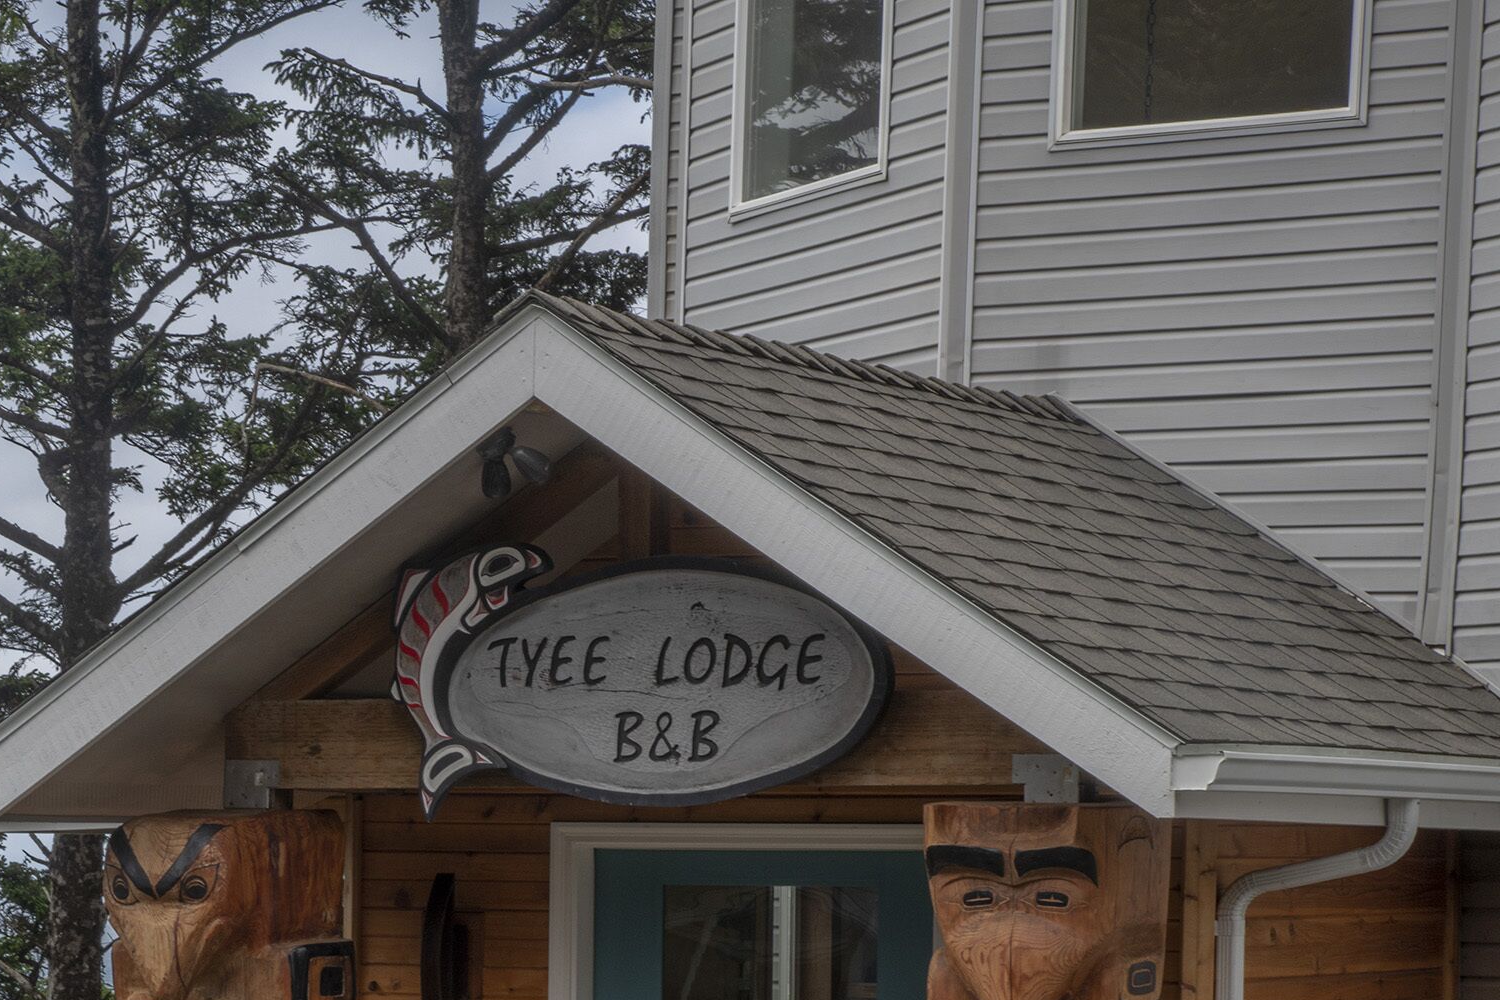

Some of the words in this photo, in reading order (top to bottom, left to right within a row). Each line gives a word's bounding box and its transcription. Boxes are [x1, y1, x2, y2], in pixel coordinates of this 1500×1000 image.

[487, 634, 611, 688] TYEE
[654, 631, 826, 691] LODGE
[612, 708, 720, 764] B&B
